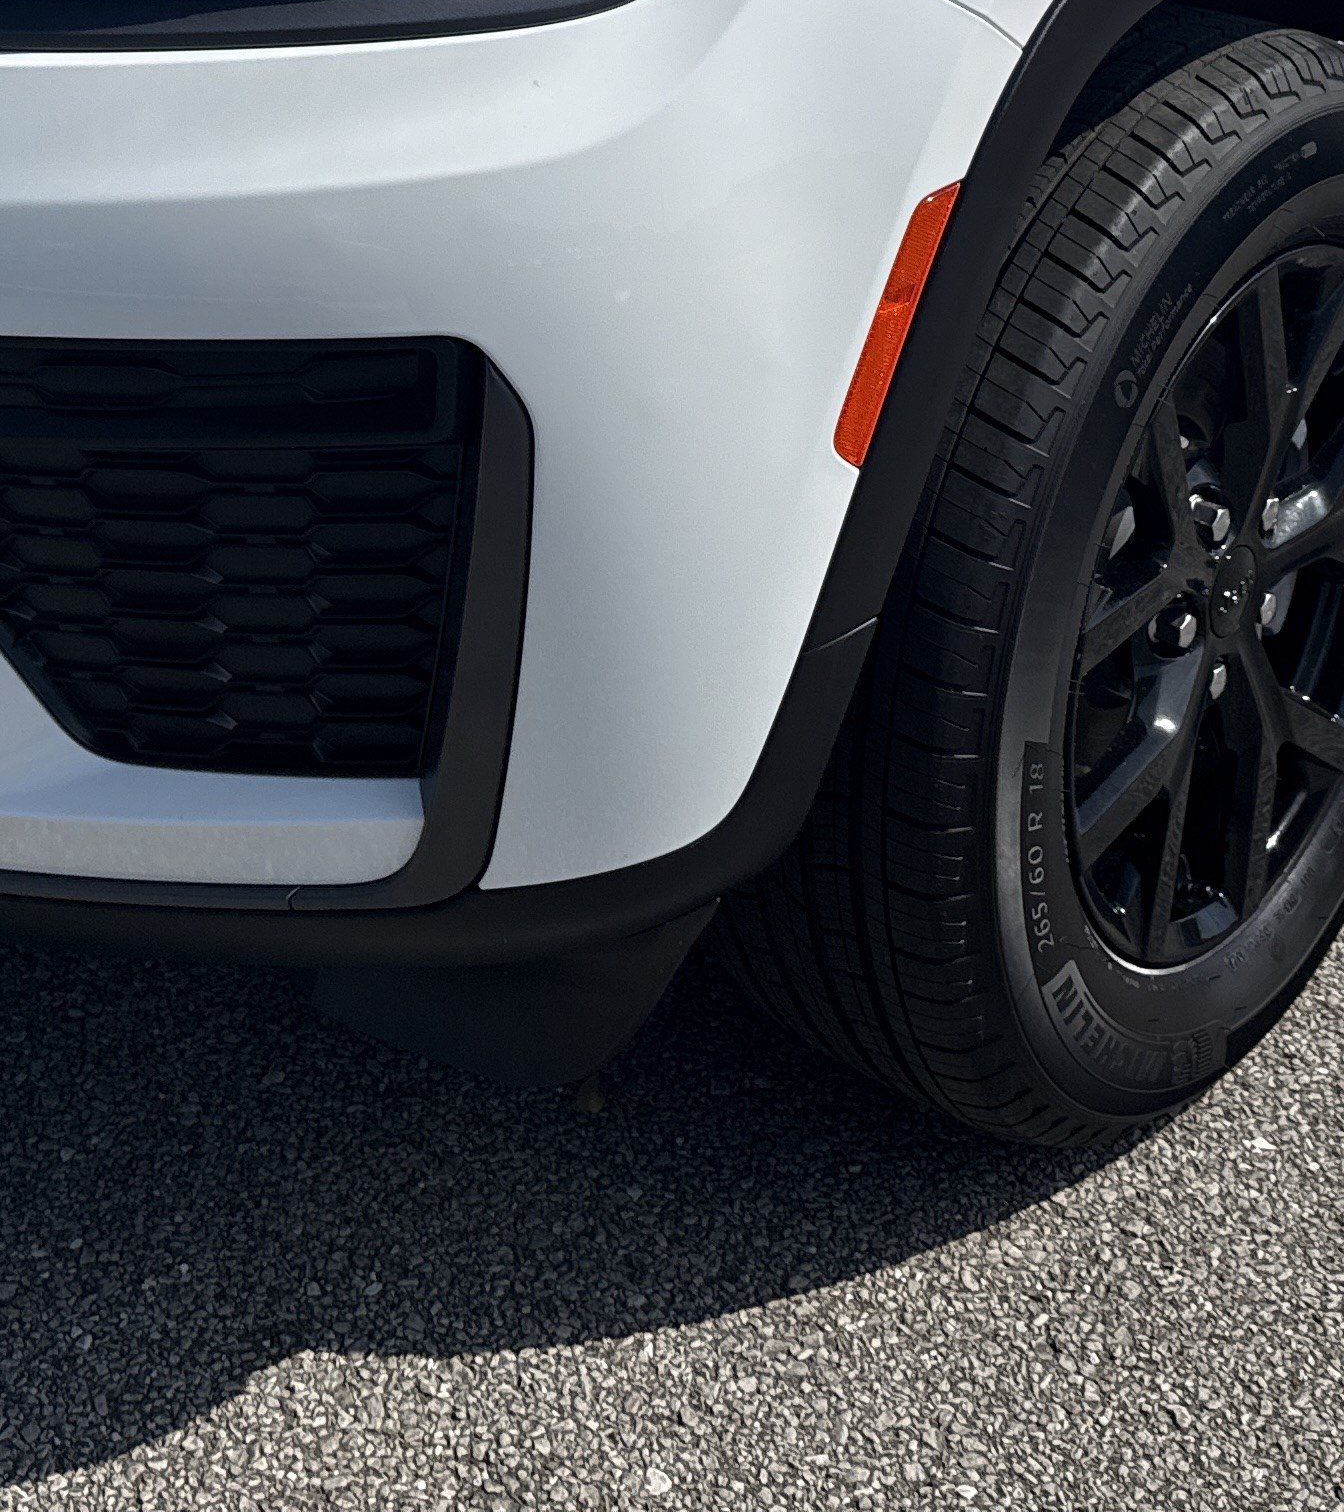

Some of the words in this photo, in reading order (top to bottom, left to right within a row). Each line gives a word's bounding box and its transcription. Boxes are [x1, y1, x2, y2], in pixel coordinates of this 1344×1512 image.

[1028, 762, 1045, 796] 18
[1026, 811, 1044, 832] R
[1027, 844, 1055, 954] 265/60
[1050, 973, 1169, 1083] MICHELIN
